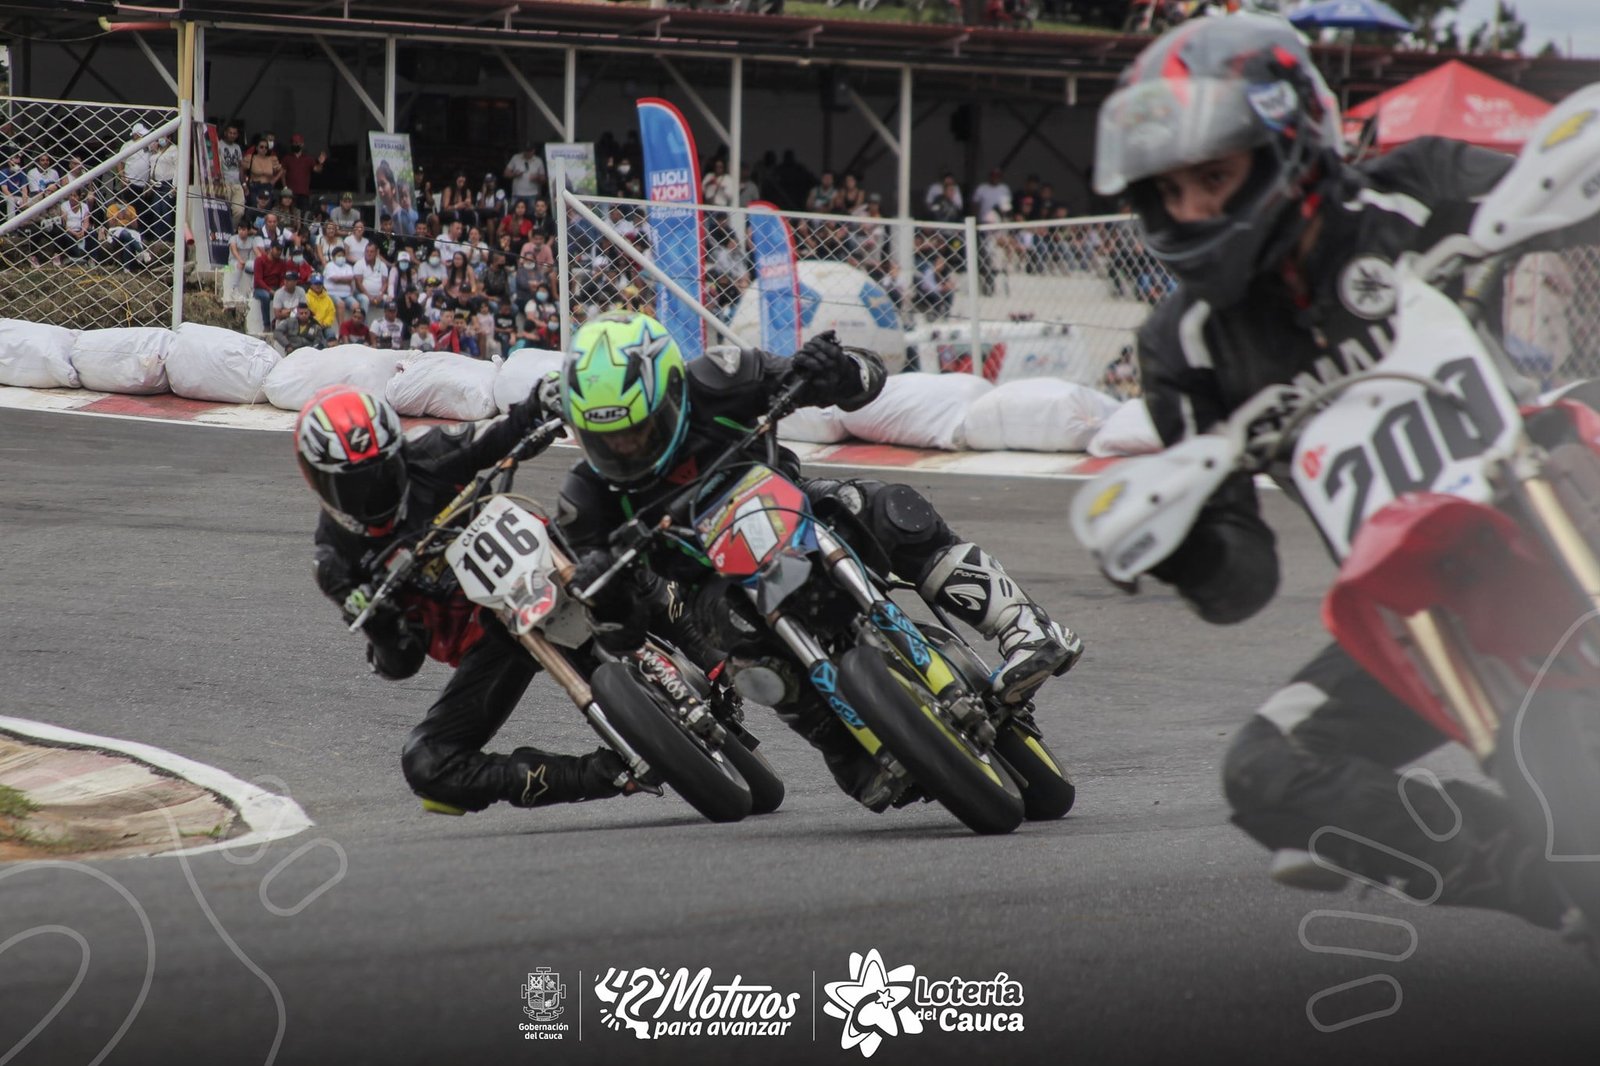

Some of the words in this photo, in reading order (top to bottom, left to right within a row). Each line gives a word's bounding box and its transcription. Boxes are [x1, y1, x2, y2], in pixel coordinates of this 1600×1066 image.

[588, 407, 626, 419] HJC
[461, 513, 495, 548] CAUCA
[461, 510, 541, 595] 196
